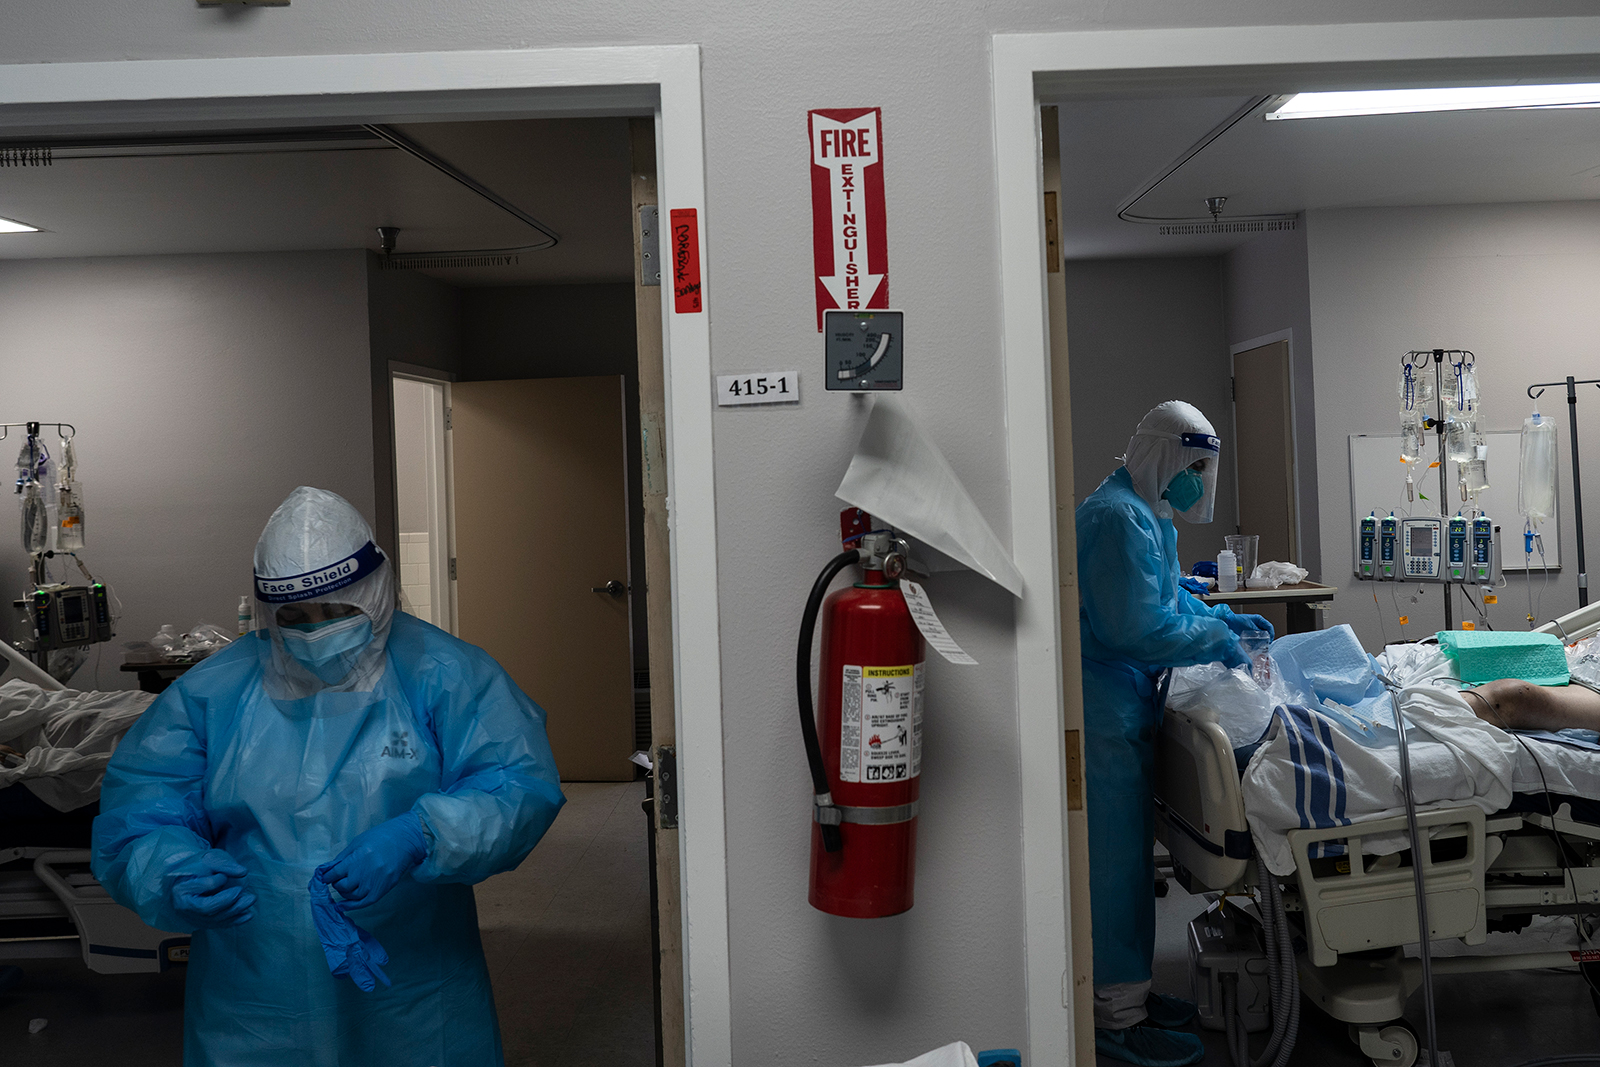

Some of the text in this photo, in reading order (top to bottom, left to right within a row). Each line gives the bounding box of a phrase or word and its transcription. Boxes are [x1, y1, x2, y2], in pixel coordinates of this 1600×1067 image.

[821, 128, 870, 157] FIRE
[842, 164, 861, 309] EXTINGUISHER
[729, 377, 789, 396] 415-1
[262, 563, 351, 593] Face Shield
[288, 590, 313, 601] Splash
[315, 577, 352, 595] Protection
[868, 668, 910, 677] INSTRUCTIONS
[381, 746, 418, 760] AIM-X
